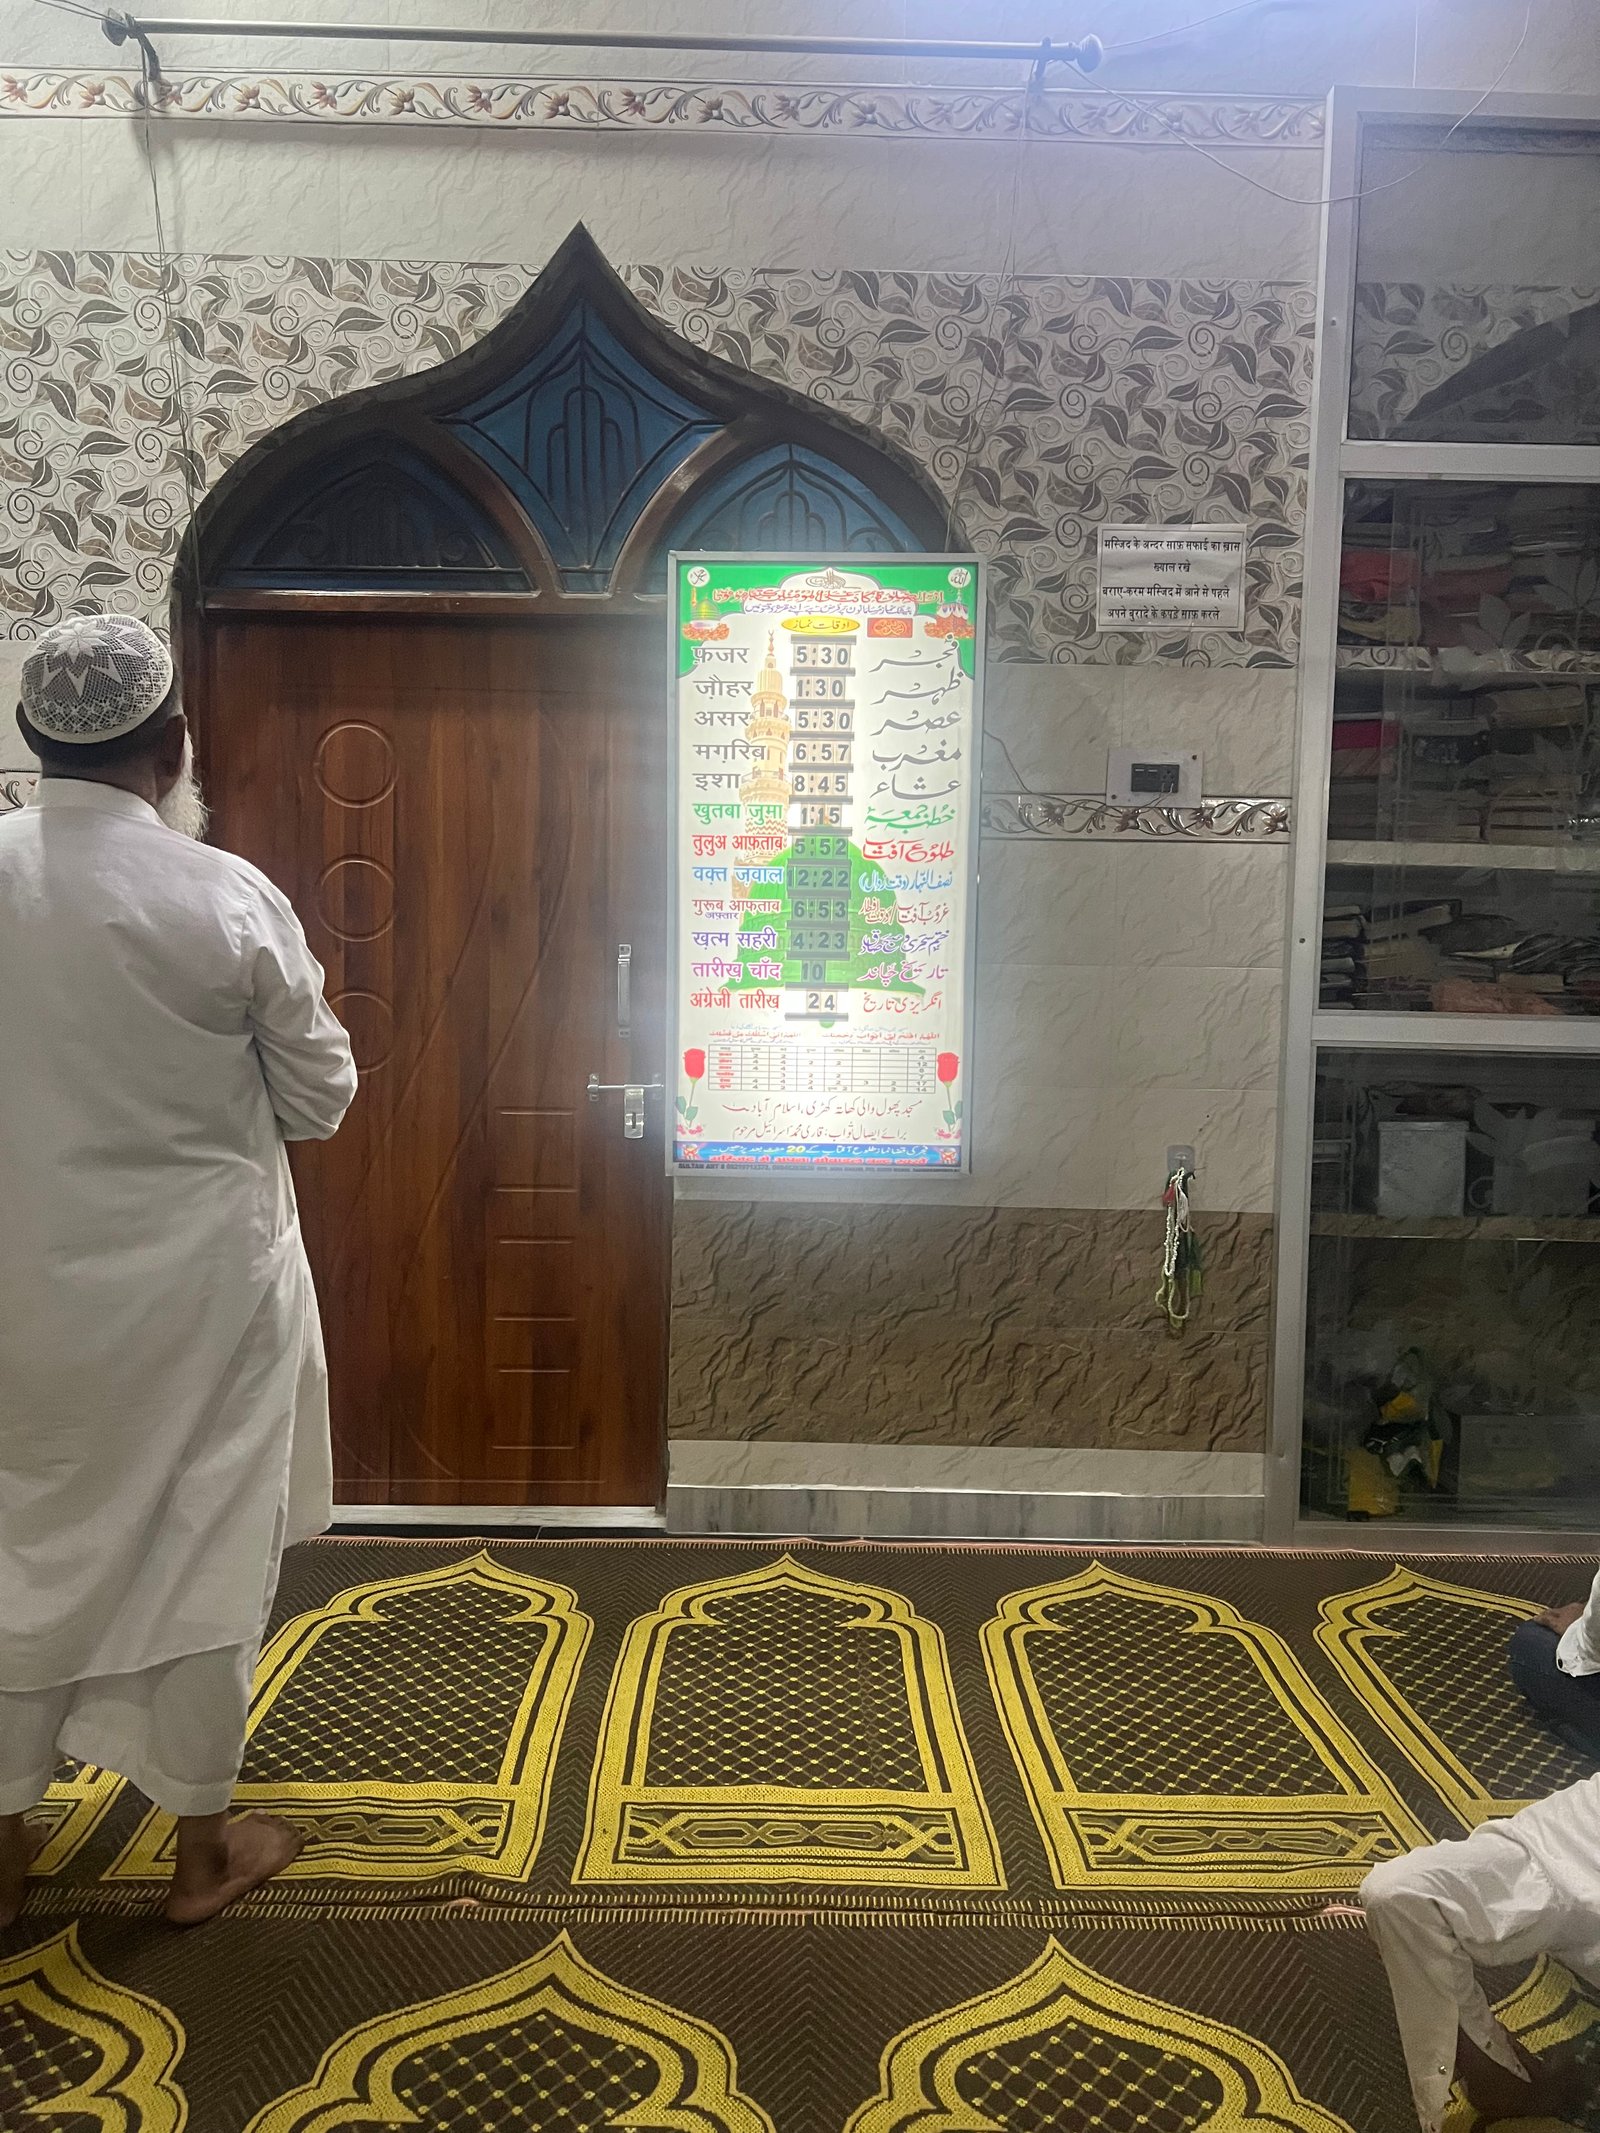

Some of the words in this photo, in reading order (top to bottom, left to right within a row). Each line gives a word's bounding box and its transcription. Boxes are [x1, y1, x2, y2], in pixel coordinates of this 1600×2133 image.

[1104, 535, 1131, 550] मस्जिद
[1133, 536, 1141, 550] के
[1143, 540, 1164, 551] अन्दर
[1210, 541, 1221, 552] का
[1147, 583, 1173, 597] मस्जिद
[1184, 584, 1200, 597] आने
[1202, 584, 1209, 597] से
[1211, 585, 1230, 600] पहले
[1107, 605, 1127, 619] अपने
[1150, 605, 1158, 619] के
[796, 645, 849, 666] 5:30
[797, 679, 844, 698] 1:30
[694, 711, 751, 727] असर
[797, 711, 850, 730] 5:30
[795, 743, 849, 763] 6:57
[692, 773, 741, 791] इशा
[794, 775, 846, 793] 8:45
[692, 803, 741, 825] खुतबा
[747, 804, 784, 825] जुमा
[801, 806, 840, 825] 1:15
[691, 835, 727, 857] तुलुअ
[794, 838, 847, 857] 5:52
[733, 867, 784, 886] ज़वाल
[787, 869, 849, 888] 12:22
[794, 901, 846, 919] 6:53
[735, 926, 777, 949] सहरी
[793, 931, 845, 950] 4:23
[802, 963, 824, 982] 10
[690, 986, 731, 1009] अंग्रेजी
[808, 993, 836, 1011] 24
[785, 1145, 806, 1153] 20
